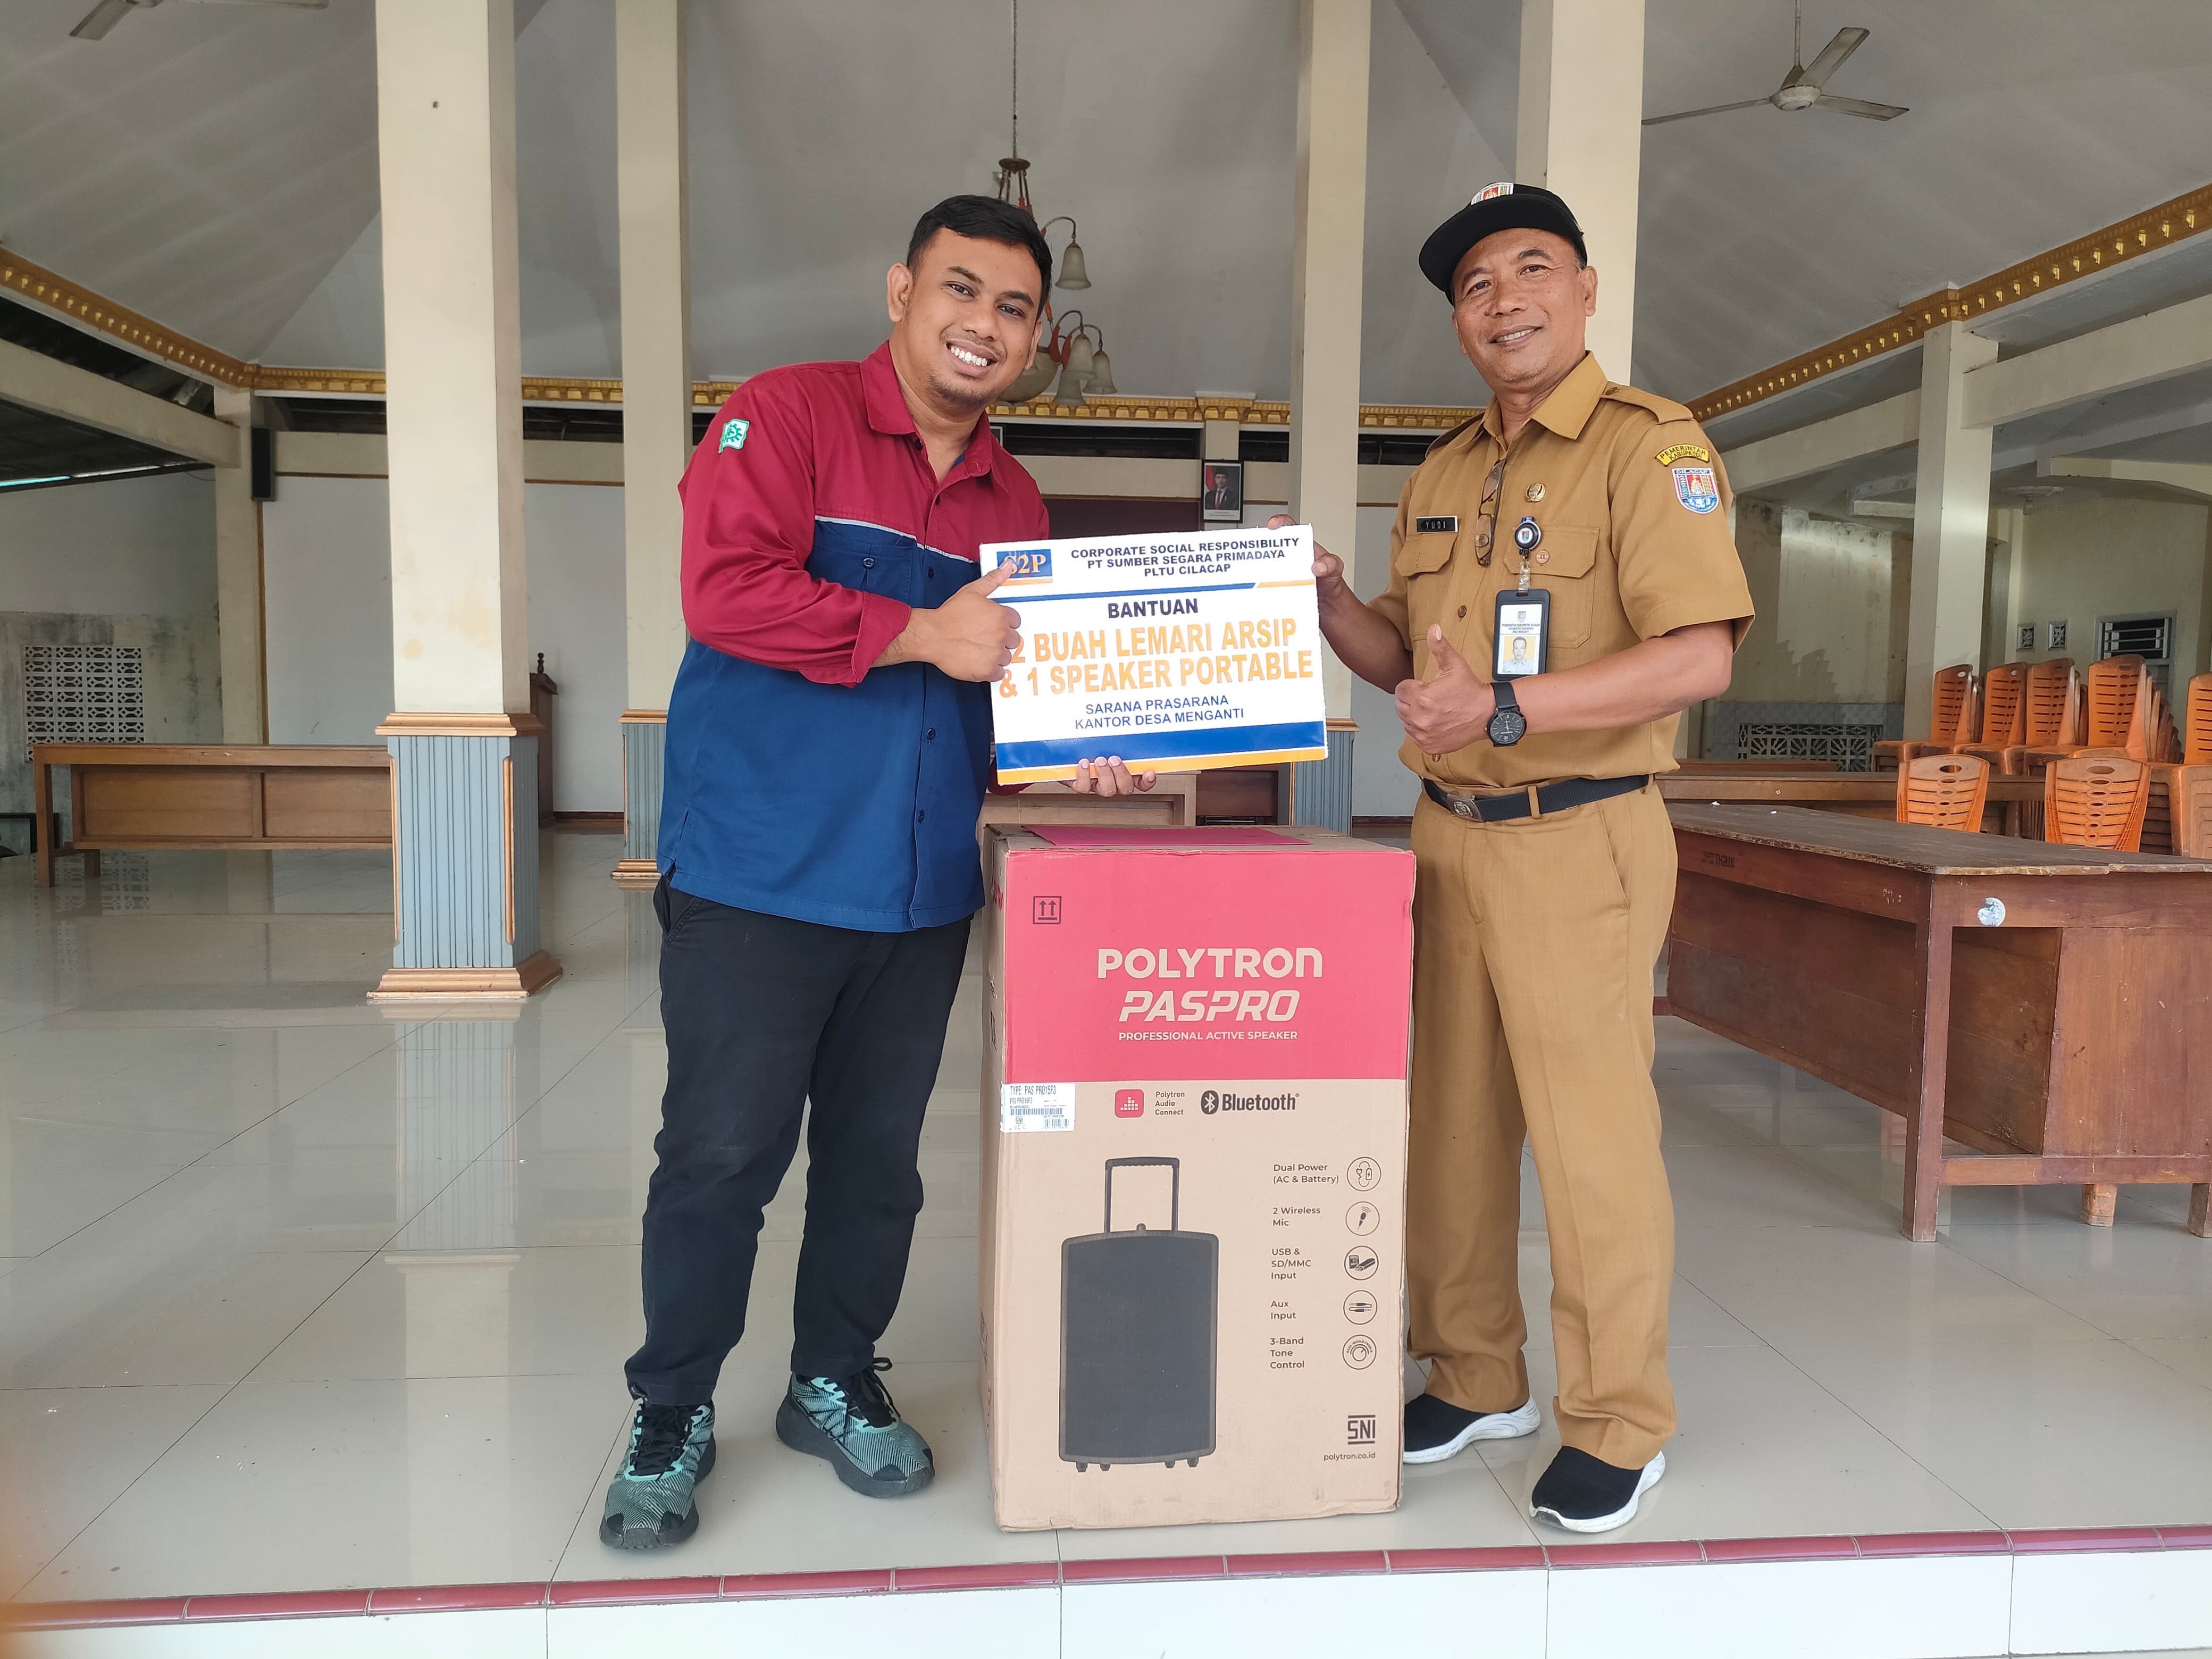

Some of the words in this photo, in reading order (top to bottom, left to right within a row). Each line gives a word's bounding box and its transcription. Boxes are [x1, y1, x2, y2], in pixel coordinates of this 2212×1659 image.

[1660, 446, 1706, 459] PEMERINTAH
[1426, 521, 1446, 530] YUDI
[1071, 547, 1146, 558] CORPORATE
[1150, 544, 1195, 554] SOCIAL
[1199, 538, 1299, 551] RESPONSIBILITY
[1087, 559, 1103, 568] PT
[1107, 556, 1159, 567] SUMBER
[1163, 554, 1212, 564] SEGARA
[1216, 550, 1285, 562] PRIMADAYA
[1144, 567, 1175, 576] PLTU
[1179, 564, 1230, 574] CILACAP
[1108, 598, 1199, 619] BANTUAN
[1011, 636, 1026, 664] 2
[1034, 630, 1107, 661] BUAH
[1116, 623, 1212, 656] LEMARI
[1222, 618, 1296, 650] ARSIP
[999, 669, 1018, 698] &
[1027, 667, 1038, 696] 1
[1051, 659, 1172, 694] SPEAKER
[1180, 650, 1313, 686] PORTABLE
[1086, 701, 1142, 715] SARANA
[1146, 695, 1229, 710] PRASARANA
[1075, 716, 1130, 730] KANTOR
[1135, 714, 1171, 725] DESA
[1175, 708, 1244, 723] MENGANTI
[1119, 990, 1301, 1022] PASPRO
[1119, 1032, 1203, 1041] PROFESSIONAL
[1206, 1031, 1245, 1040] ACTIVE
[1247, 1030, 1297, 1040] SPEAKER
[1010, 1086, 1023, 1095] TYPE:
[1025, 1085, 1034, 1095] PAS
[1273, 1175, 1289, 1185] (AC
[1301, 1175, 1339, 1184] Battery)
[1271, 1259, 1312, 1268] SD/MMC
[1271, 1271, 1297, 1280] Input
[1270, 1312, 1296, 1321] Input
[1270, 1336, 1304, 1345] 3-Band
[1348, 1420, 1376, 1439] SNI
[1323, 1452, 1376, 1462] polytron.co.id
